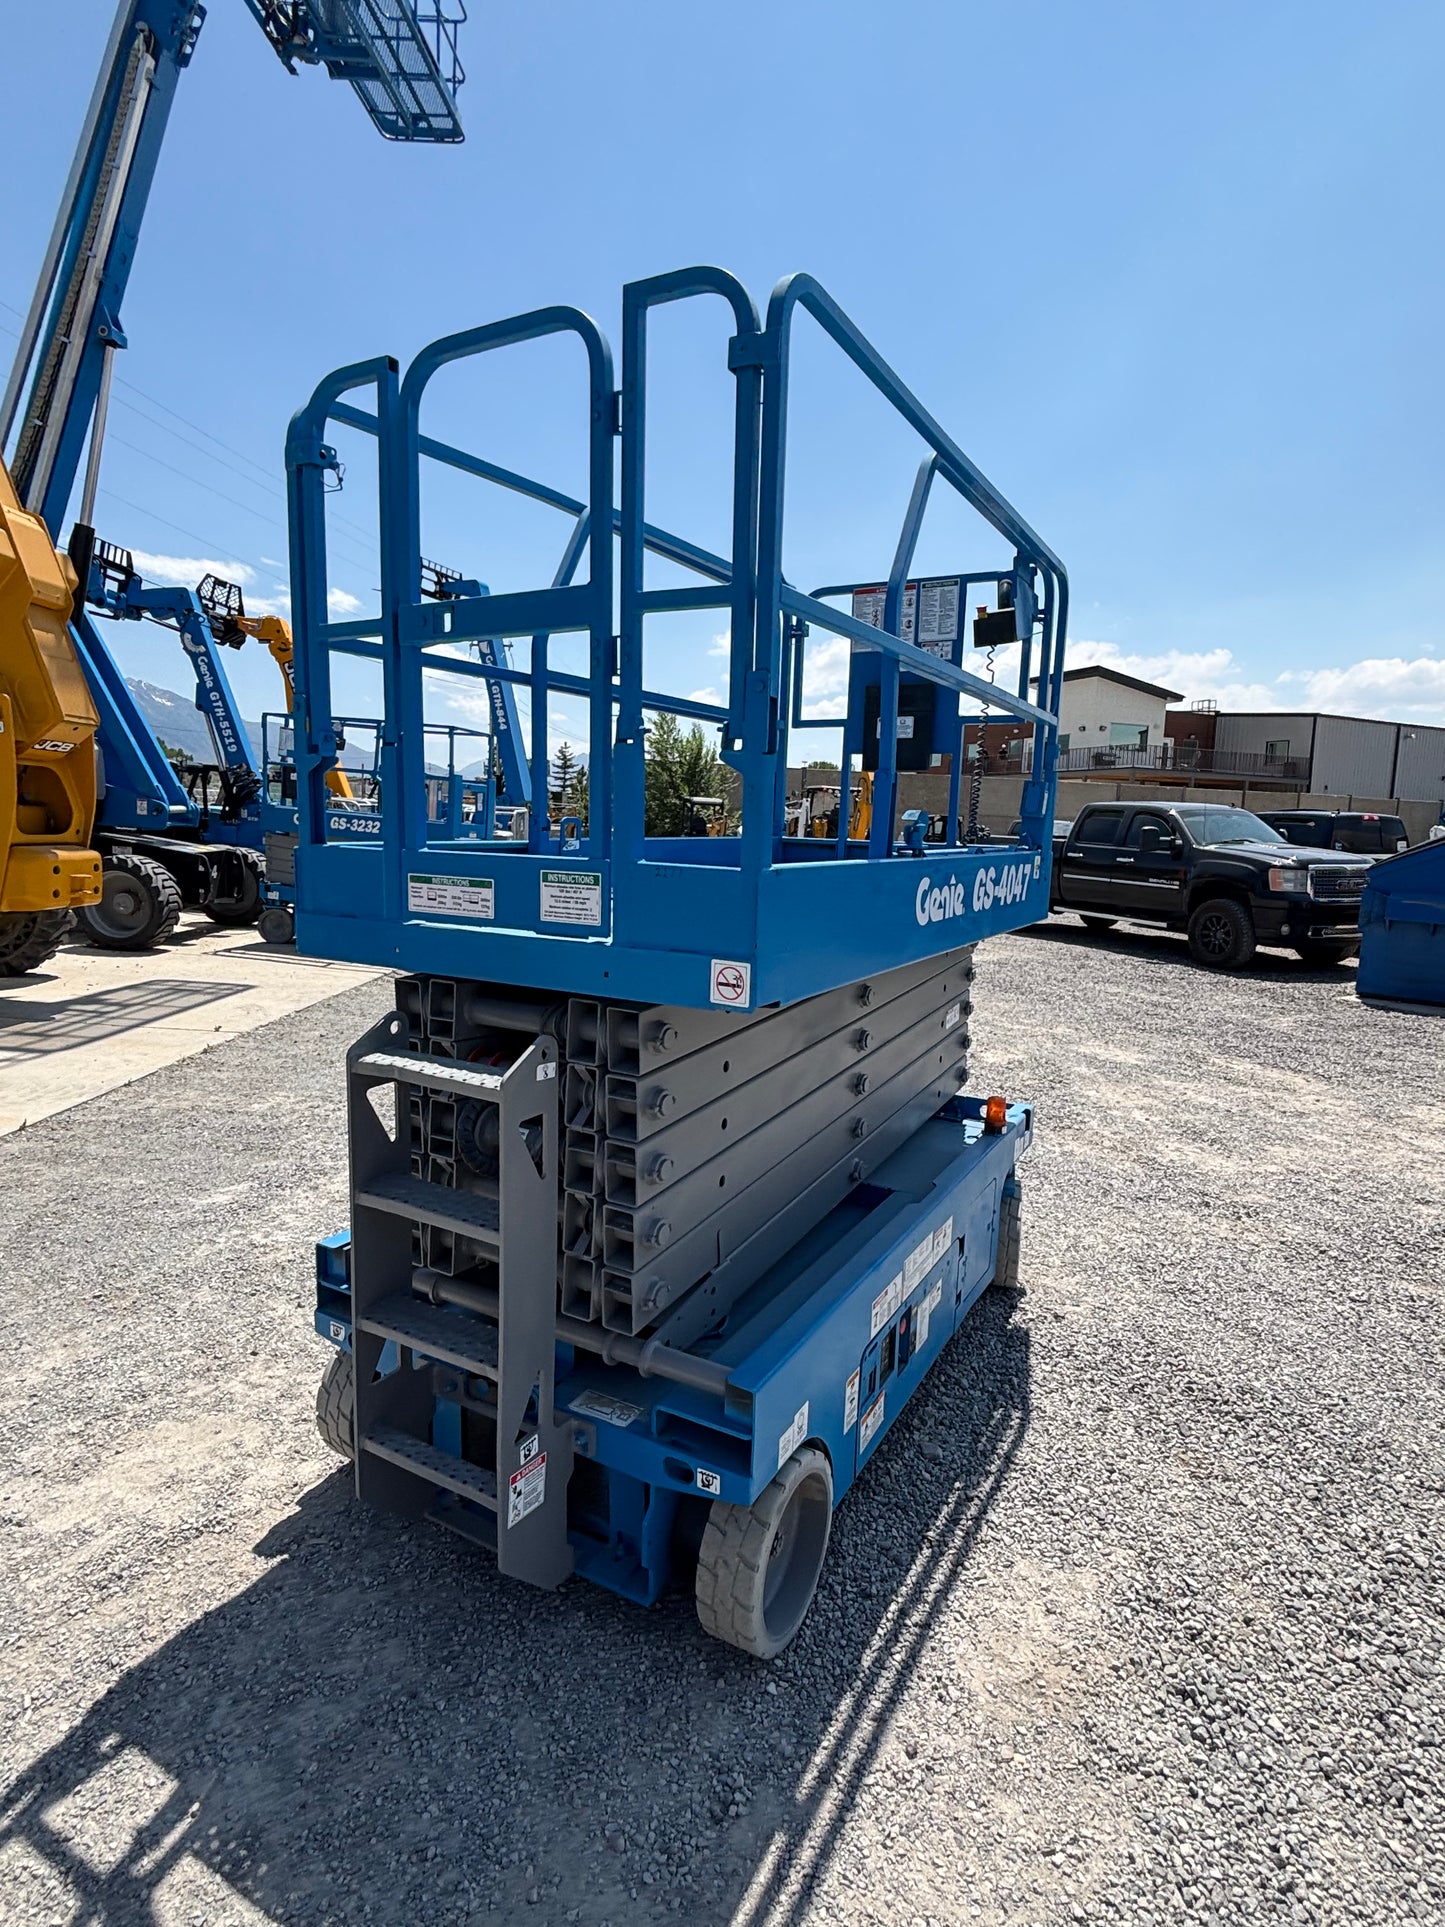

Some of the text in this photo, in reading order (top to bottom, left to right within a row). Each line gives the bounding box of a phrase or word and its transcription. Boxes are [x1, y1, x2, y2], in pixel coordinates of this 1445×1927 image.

[197, 656, 237, 752] Genie GTH-5519
[33, 740, 75, 752] JCB
[330, 817, 381, 834] GS-3232
[432, 877, 470, 887] INSTRUCTIONS
[547, 873, 595, 885] INSTRUCTIONS
[916, 863, 1031, 926] Genie GS-4047
